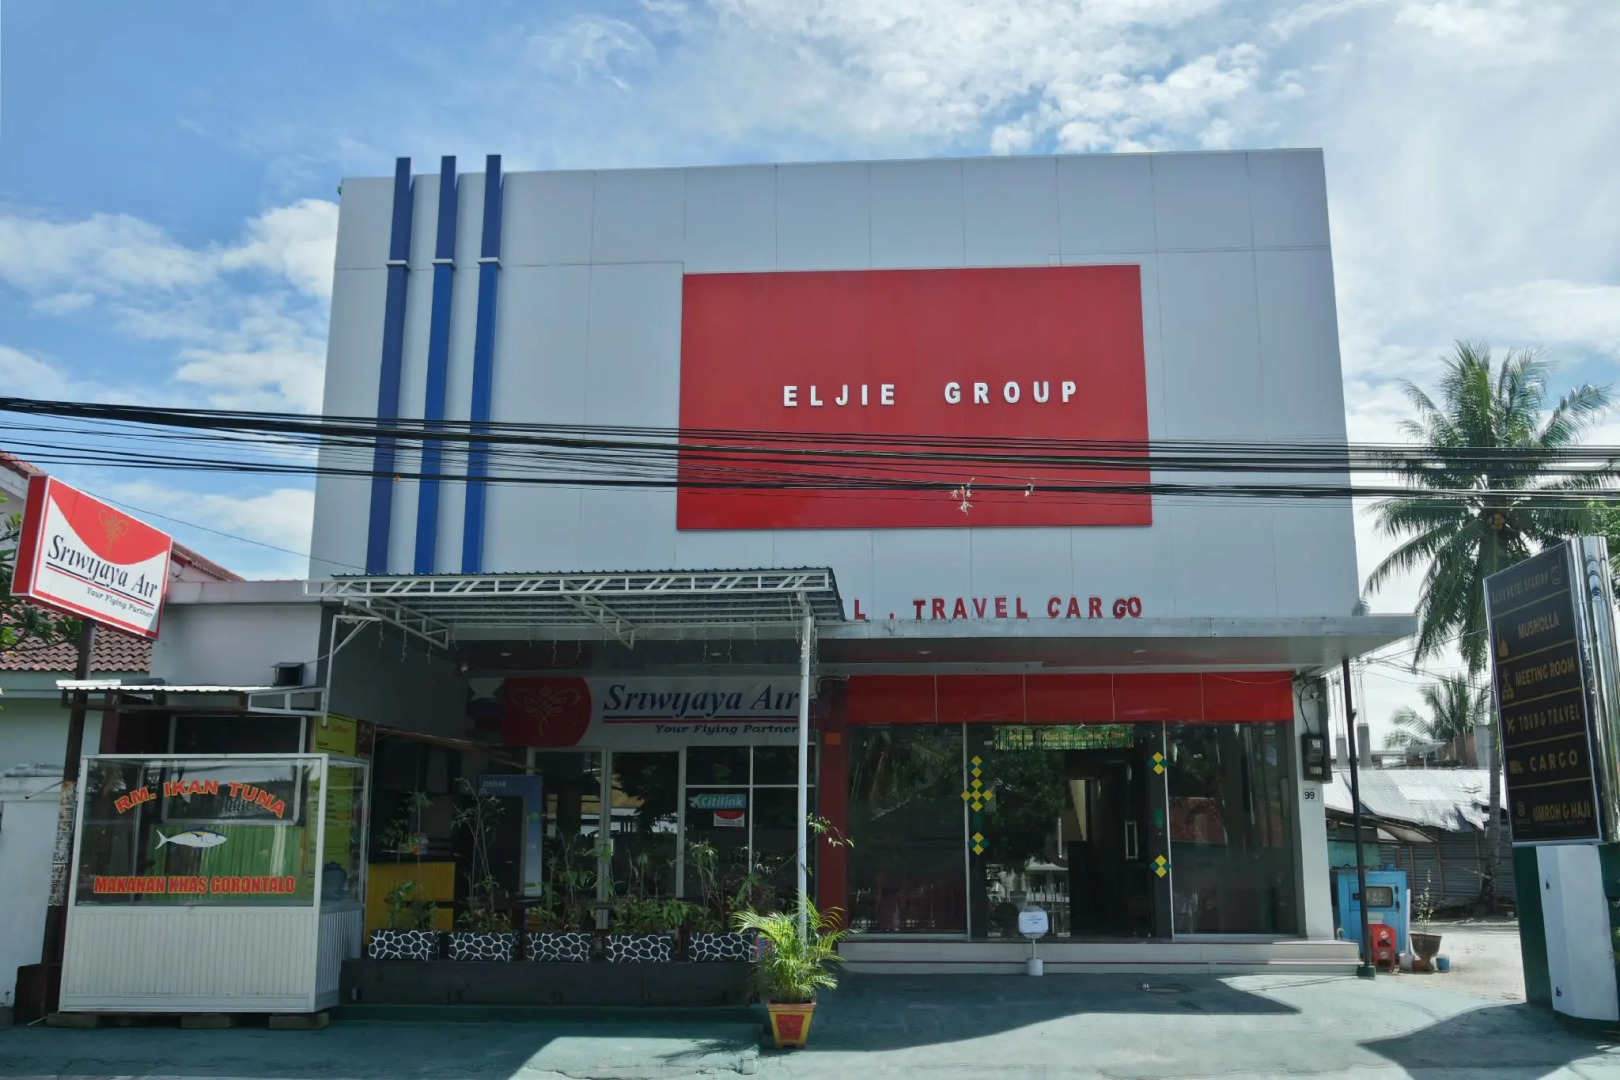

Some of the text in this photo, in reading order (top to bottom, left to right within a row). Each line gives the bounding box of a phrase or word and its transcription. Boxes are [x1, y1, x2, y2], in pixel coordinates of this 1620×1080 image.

[783, 381, 1076, 407] ELJIE GROUP
[47, 534, 158, 599] Sriwijaya Air
[86, 587, 153, 619] Your Flying Partner
[912, 596, 1028, 620] TRAVEL
[1047, 596, 1142, 620] CARGO
[1517, 611, 1561, 639] MUSHOLLA
[1515, 657, 1576, 687] MEETING ROOM
[602, 684, 800, 718] Sriwijaya Air
[655, 723, 799, 736] Your Flying Partner
[1519, 713, 1540, 731] TOUR
[1547, 704, 1580, 726] TRAVEL
[1529, 750, 1579, 772] CARGO
[113, 779, 287, 820] RM. IKAN TUNA
[701, 795, 744, 808] Citilink
[1304, 791, 1315, 800] 99
[1532, 803, 1561, 822] UMROH
[1570, 800, 1592, 819] HAJI
[93, 875, 296, 894] MAKANAN KHAS GORONTALO
